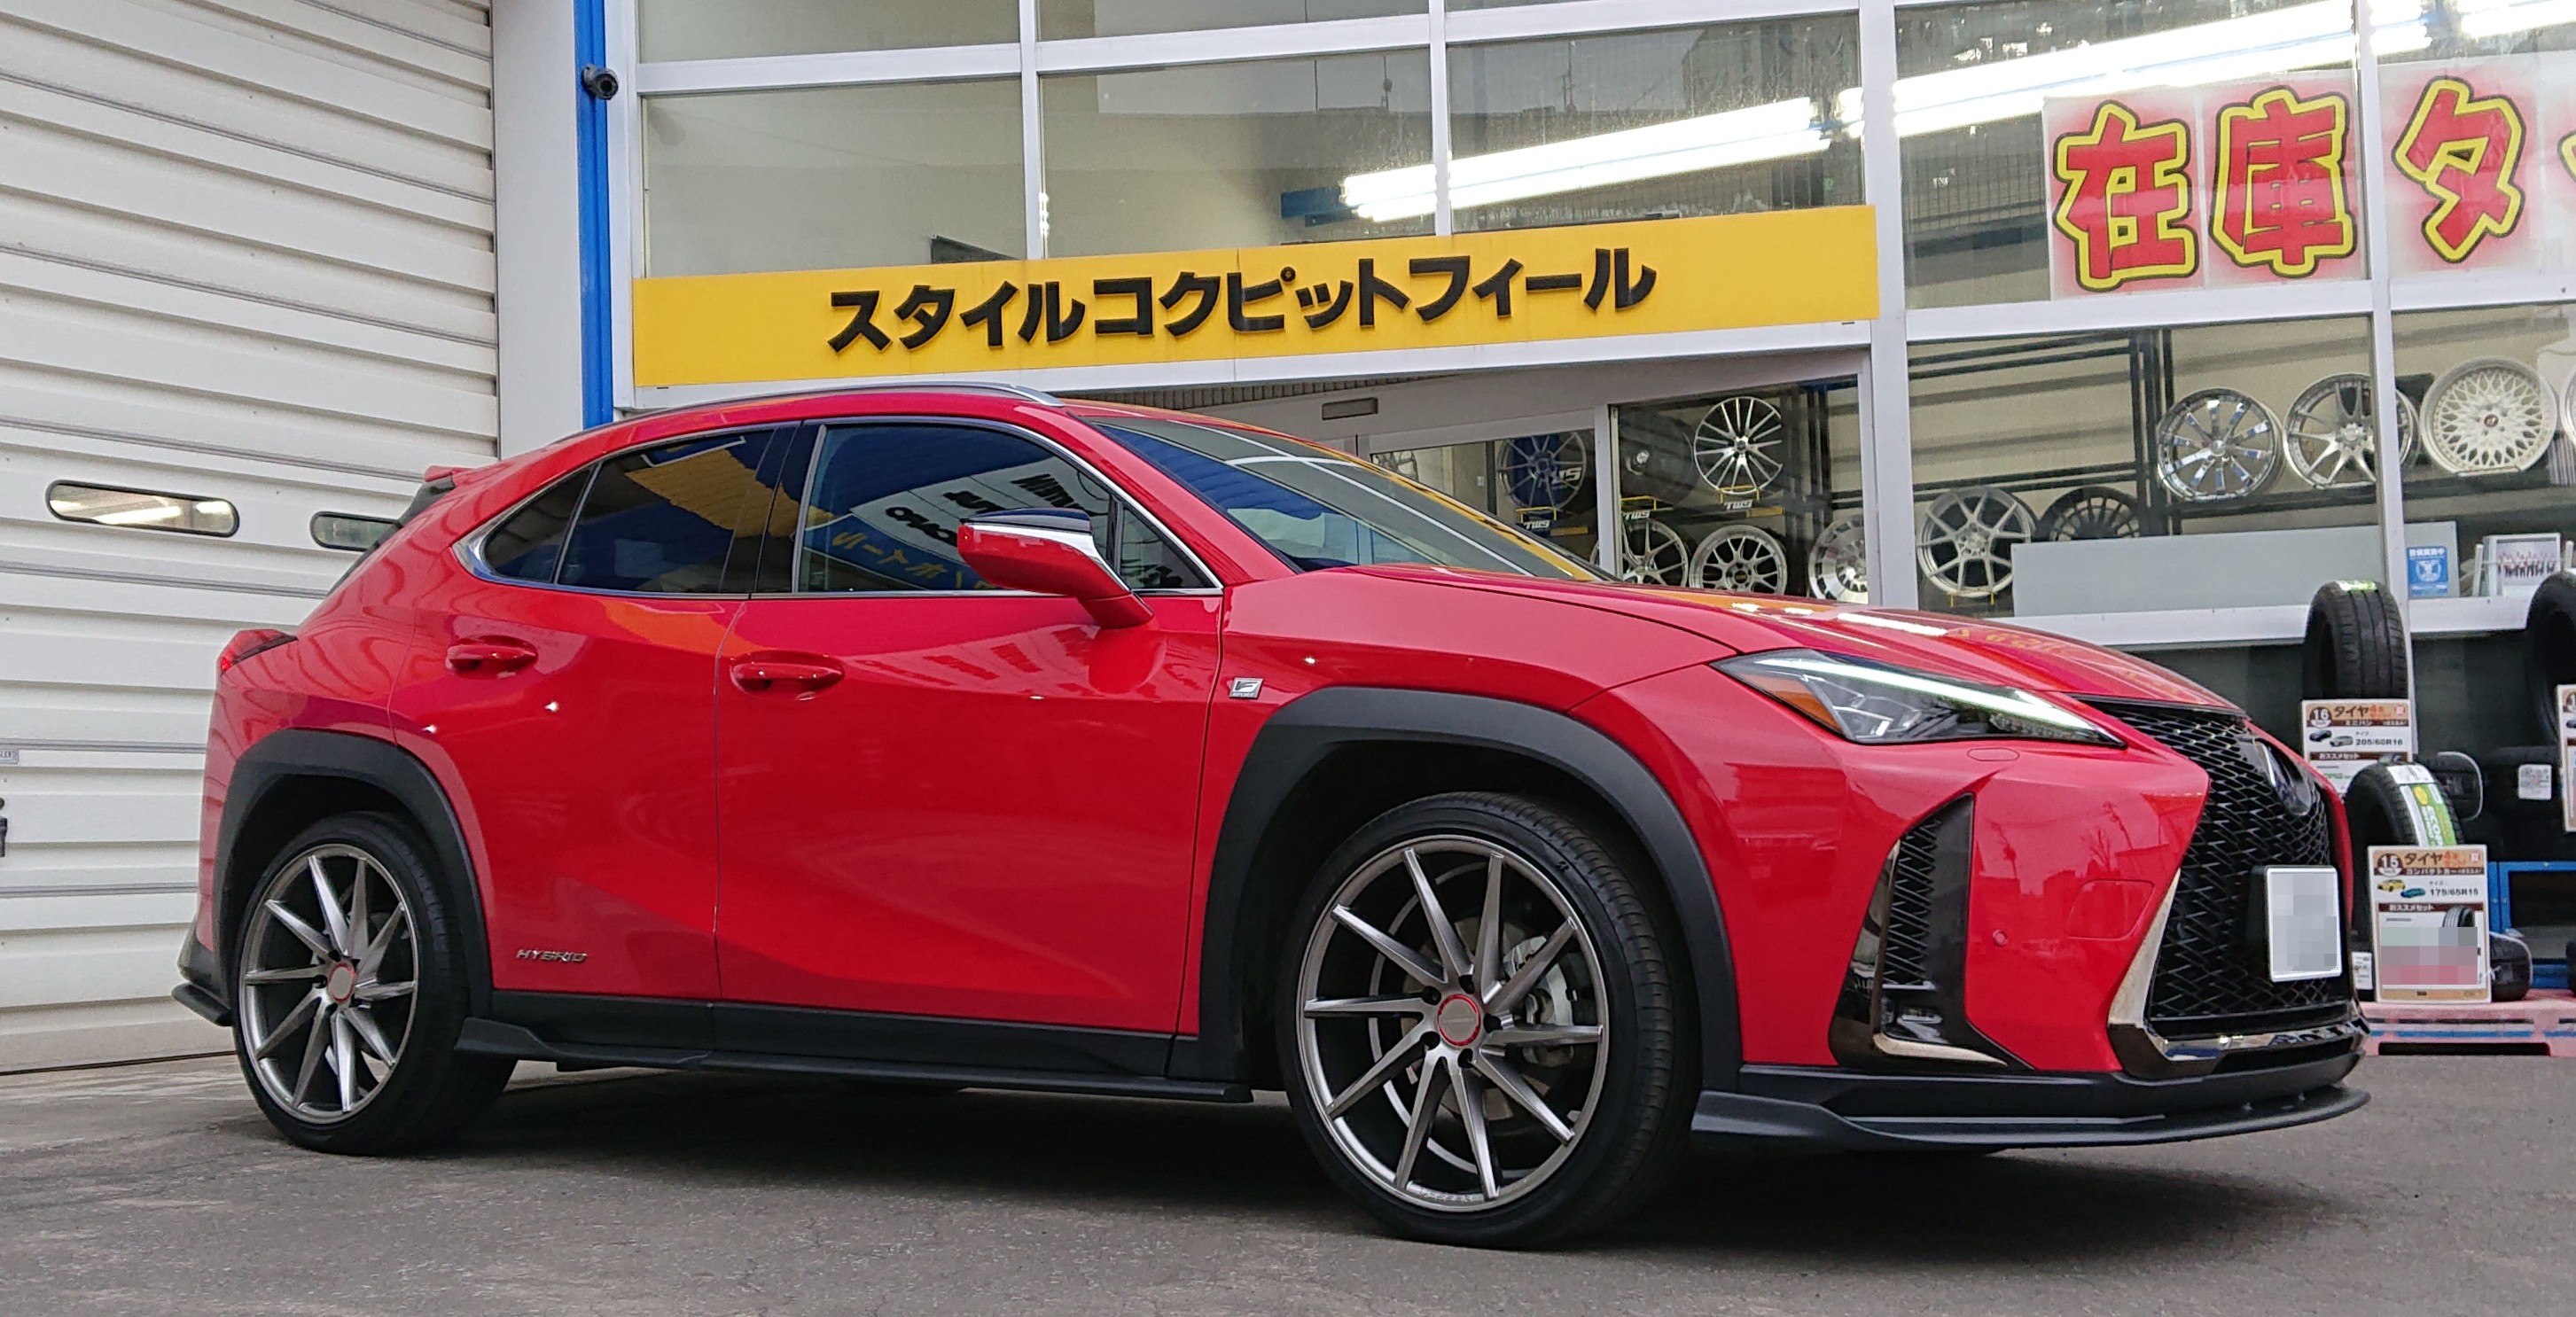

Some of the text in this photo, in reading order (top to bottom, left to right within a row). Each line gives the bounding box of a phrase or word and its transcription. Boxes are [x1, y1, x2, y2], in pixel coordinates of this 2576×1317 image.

[2053, 75, 2576, 292] 在庫タ
[827, 248, 1658, 353] スタイルコクピットフィール
[2313, 708, 2330, 721] 16
[2334, 705, 2369, 718] タイヤ
[2382, 855, 2399, 869] 15
[2404, 852, 2443, 866] タイヤ
[516, 948, 588, 962] HYBRID
